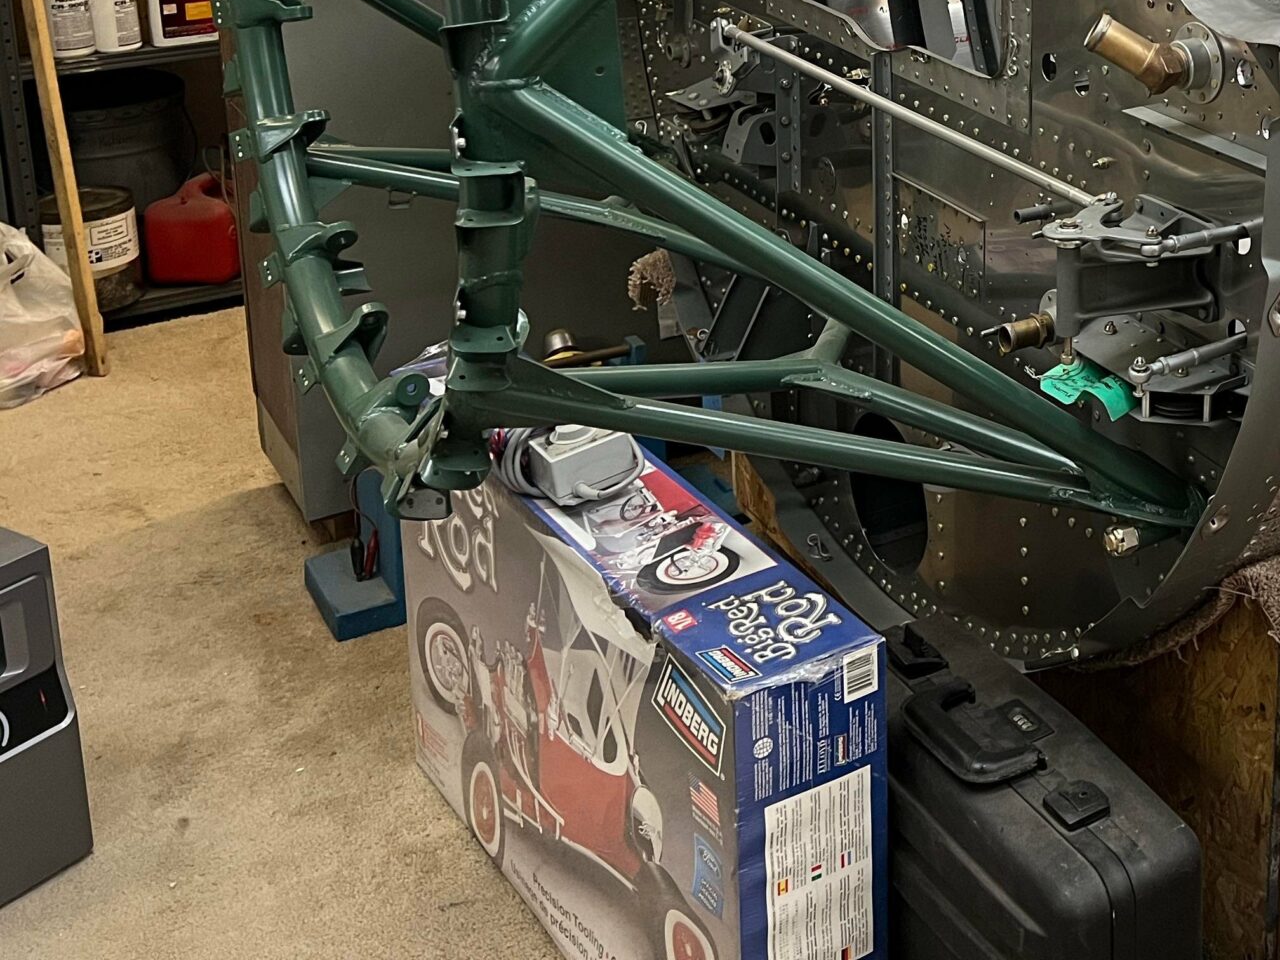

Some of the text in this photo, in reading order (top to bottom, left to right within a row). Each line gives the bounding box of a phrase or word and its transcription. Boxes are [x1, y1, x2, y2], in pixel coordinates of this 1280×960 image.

[667, 611, 695, 632] 1/8
[706, 595, 797, 665] Big Red
[740, 580, 842, 645] Rod
[657, 664, 719, 756] LINDBERG
[532, 872, 605, 960] Precision Tooling
[550, 913, 590, 960] précision
